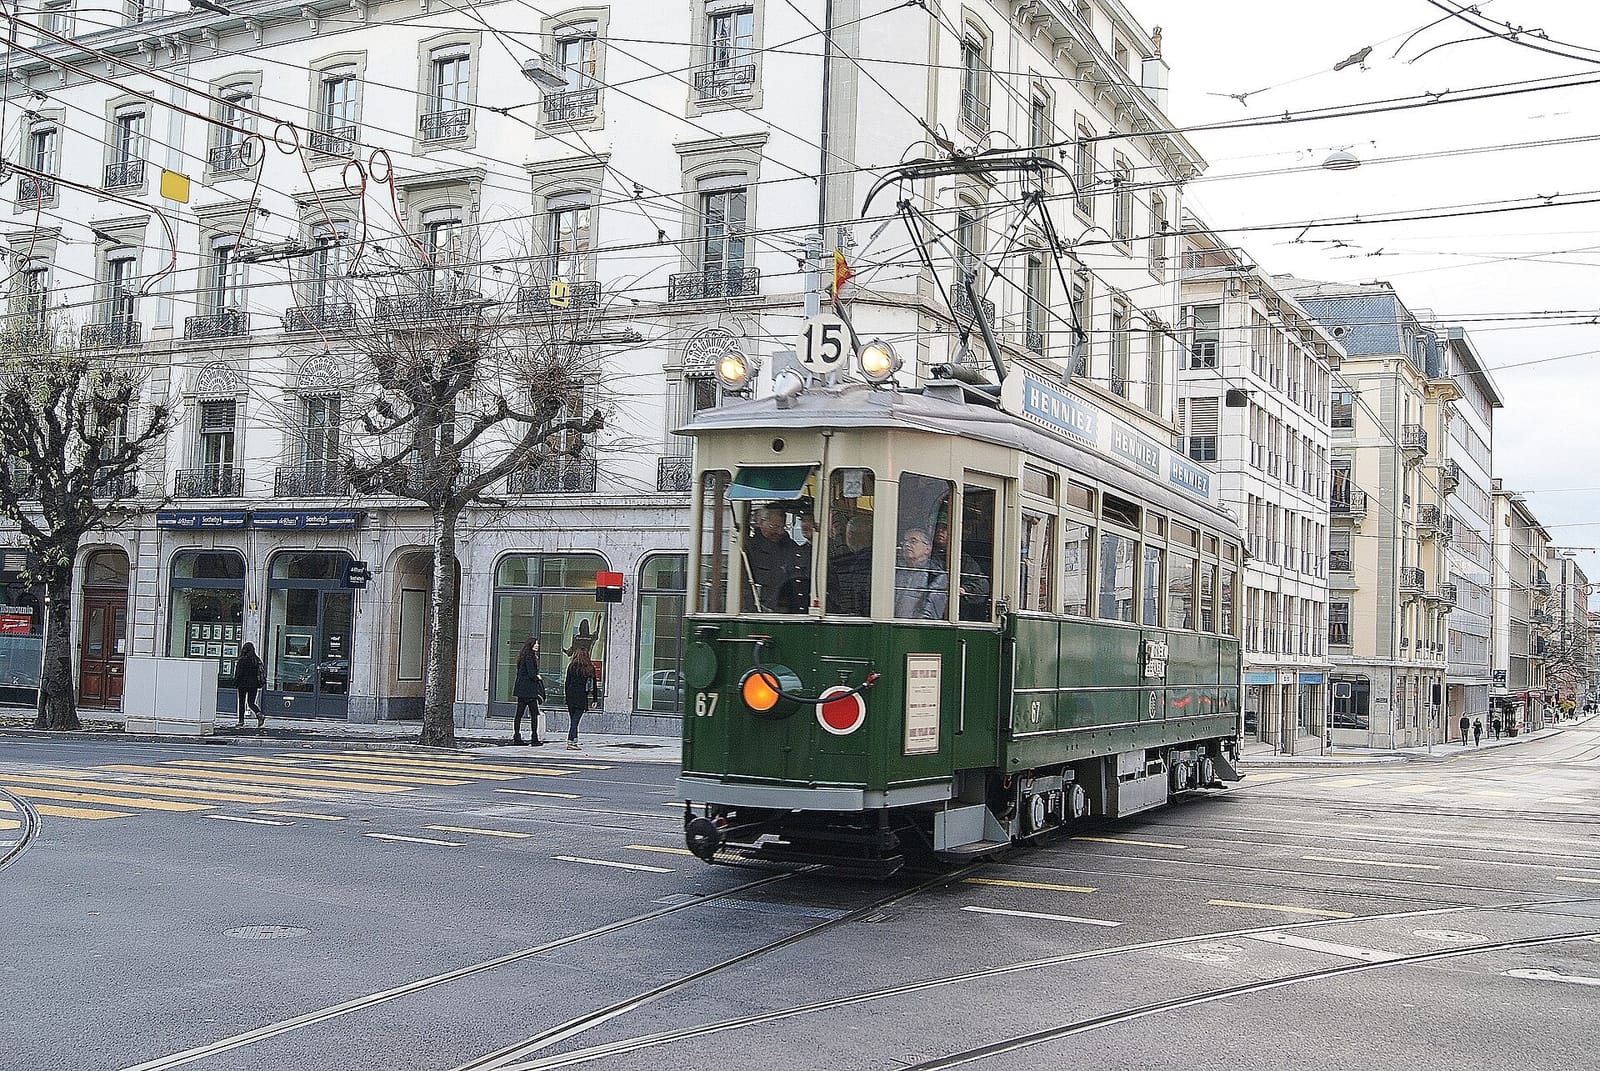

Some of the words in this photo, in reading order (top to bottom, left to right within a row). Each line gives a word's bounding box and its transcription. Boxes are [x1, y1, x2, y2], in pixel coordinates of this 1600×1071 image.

[803, 324, 841, 363] 15
[1030, 385, 1093, 434] HENNIEZ
[1114, 430, 1158, 468] HENNIEZ
[1171, 461, 1208, 494] HENNIEZ
[696, 693, 718, 716] 67
[1031, 701, 1041, 723] 67
